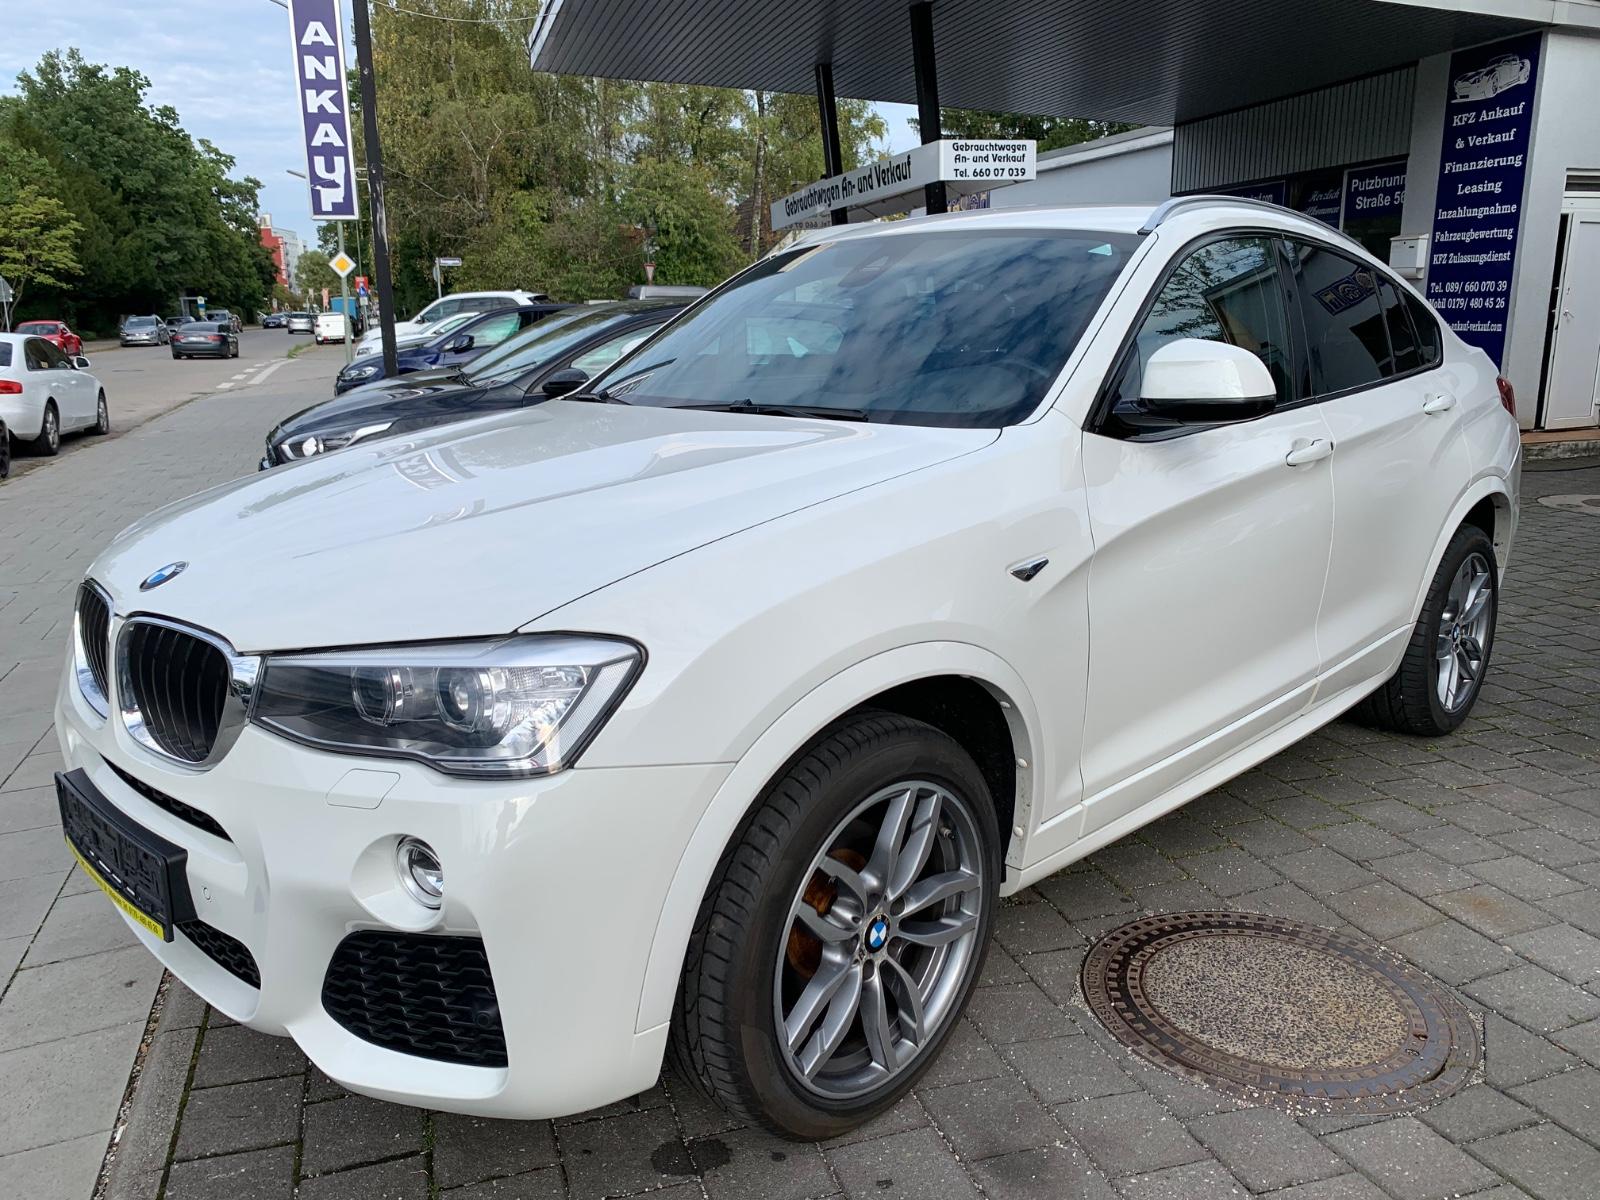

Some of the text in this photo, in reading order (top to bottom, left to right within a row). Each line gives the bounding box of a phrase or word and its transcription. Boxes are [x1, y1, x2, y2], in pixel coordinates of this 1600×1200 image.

[1452, 102, 1526, 126] KFZ Ankauf
[1455, 128, 1517, 149] & Verkauf
[952, 142, 1027, 153] Gebrauchtwagen
[954, 153, 1026, 163] An- und Verkauf
[1444, 153, 1524, 174] Finanzierung
[953, 167, 1026, 177] Tel. 660 07 039
[785, 154, 911, 217] Gebrauchtwagen An- und Verkauf
[1457, 180, 1503, 195] Leasing
[1355, 193, 1391, 210] Straße
[1437, 203, 1517, 219] Inzahlungnahme
[1434, 227, 1514, 243] Fahrzeugbewertung
[1432, 250, 1511, 265] KFZ Zulassungsdienst
[1430, 280, 1508, 294] Tel. 089/ 660 070 39
[1447, 297, 1468, 310] 0179/
[1469, 297, 1483, 309] 480
[1484, 297, 1495, 309] 45
[1495, 297, 1505, 309] 26
